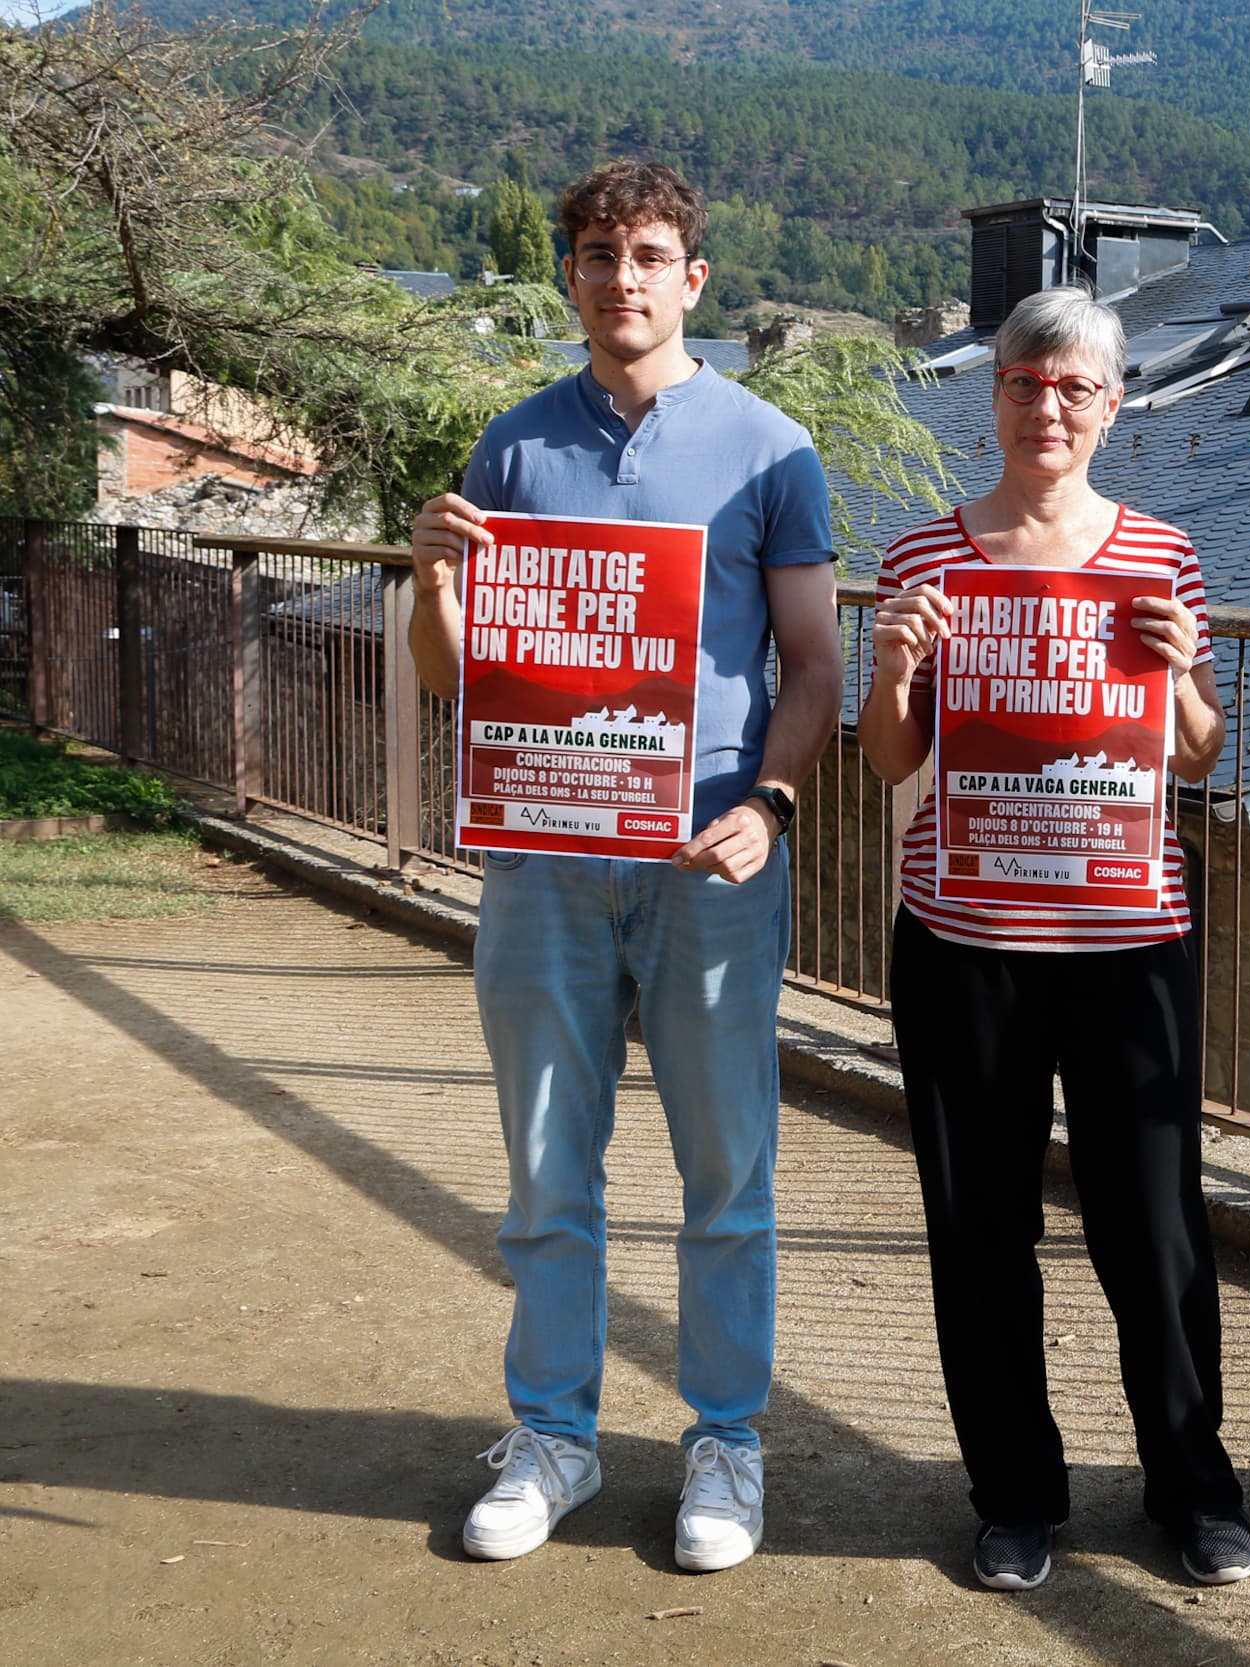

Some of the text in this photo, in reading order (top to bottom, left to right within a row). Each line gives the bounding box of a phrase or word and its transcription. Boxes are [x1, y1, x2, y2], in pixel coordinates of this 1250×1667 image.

[475, 544, 645, 592] HABITATGE
[473, 585, 637, 633] DIGNE PER
[950, 596, 1116, 640] HABITATGE
[471, 627, 675, 672] UN PIRINEU VIU
[949, 637, 1106, 680] DIGNE PER
[947, 678, 1145, 718] UN PIRINEU VIU
[484, 725, 665, 751] CAP A LA VAGA GENERAL
[516, 753, 631, 773] CONCENTRACIONS
[494, 768, 535, 783] DIJOUS
[627, 777, 640, 789] 19
[644, 778, 652, 790] H
[959, 775, 1136, 797] CAP A LA VAGA GENERAL
[493, 783, 523, 796] PLAÇA
[525, 785, 548, 796] DELS
[578, 789, 589, 799] LA
[591, 790, 609, 800] SEU
[989, 802, 1101, 819] CONCENTRACIONS
[542, 819, 600, 831] PIRINEU VIU
[624, 819, 672, 832] COSHAC
[969, 818, 1007, 832] DIJOUS
[1097, 823, 1111, 836] 19
[1115, 824, 1122, 836] H
[969, 834, 996, 846] PLAÇA
[998, 835, 1019, 846] DELS
[1048, 837, 1059, 847] LA
[1061, 838, 1078, 848] SEU
[1014, 869, 1069, 880] PIRINEU VIU
[1094, 867, 1142, 879] COSHAC
